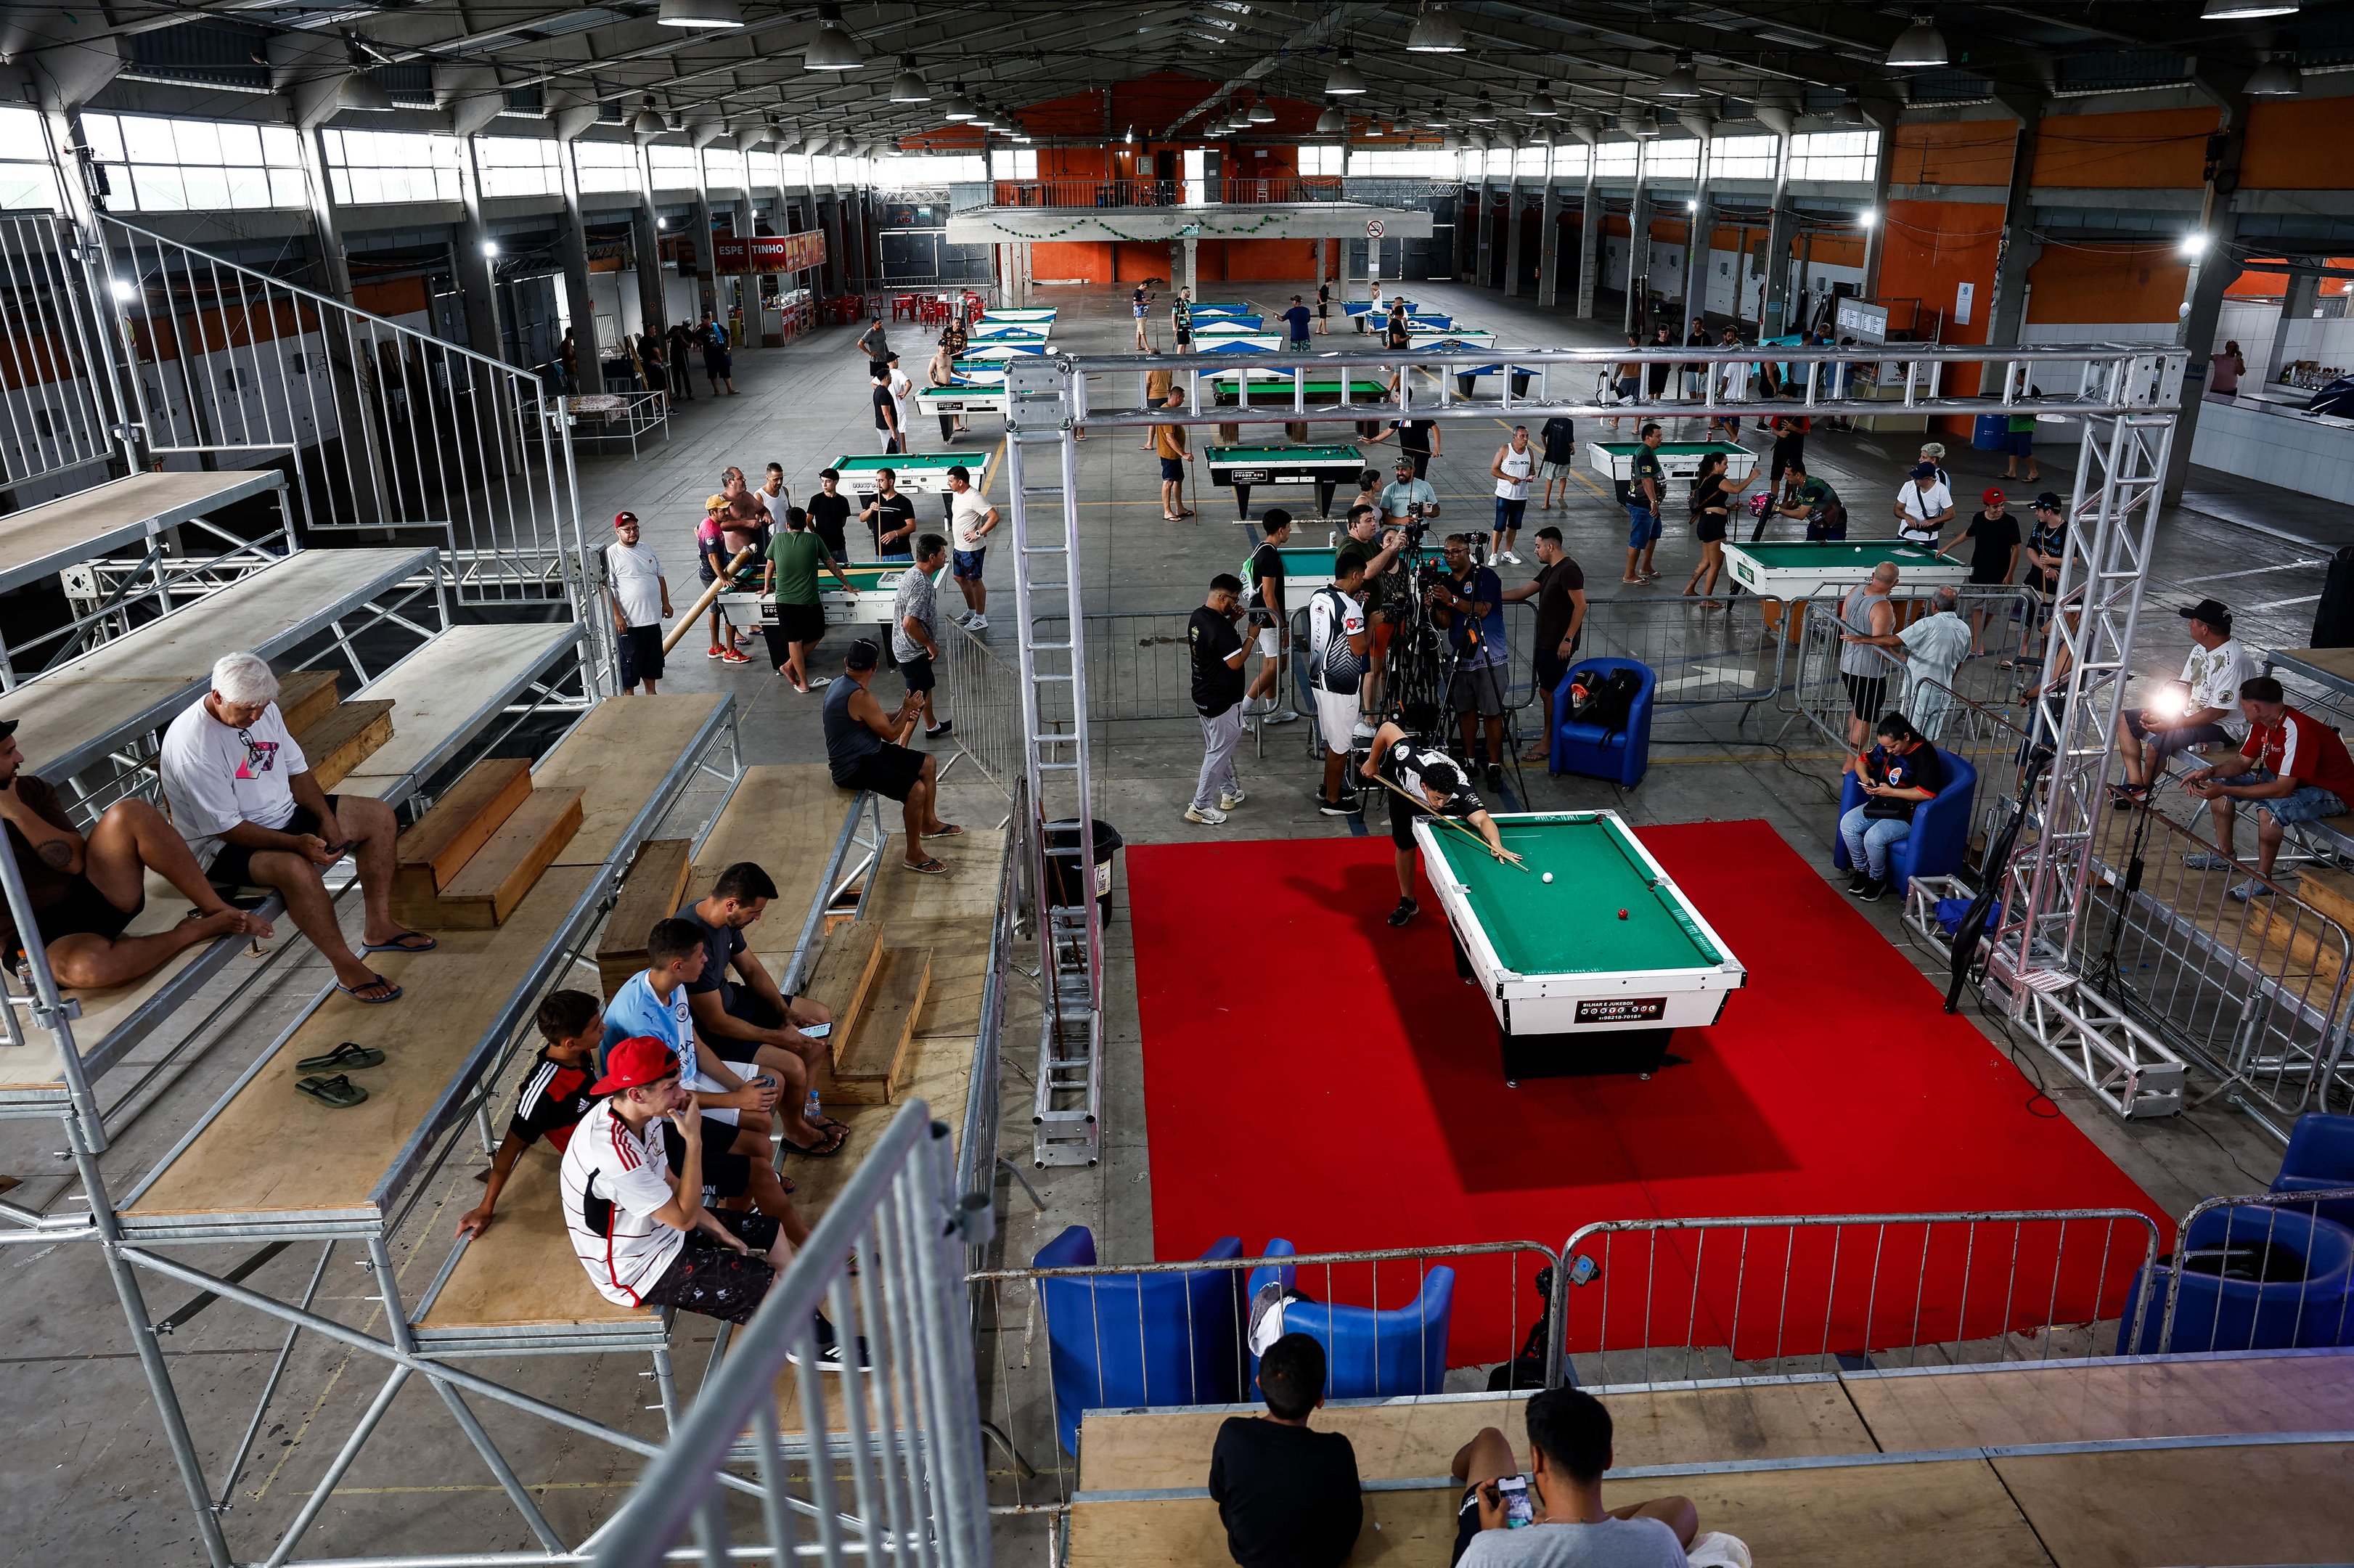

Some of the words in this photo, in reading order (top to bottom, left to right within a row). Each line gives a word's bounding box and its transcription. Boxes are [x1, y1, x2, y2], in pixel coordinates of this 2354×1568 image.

[719, 245, 743, 255] ESPE
[751, 244, 784, 254] TINHO
[1397, 747, 1409, 759] SNK
